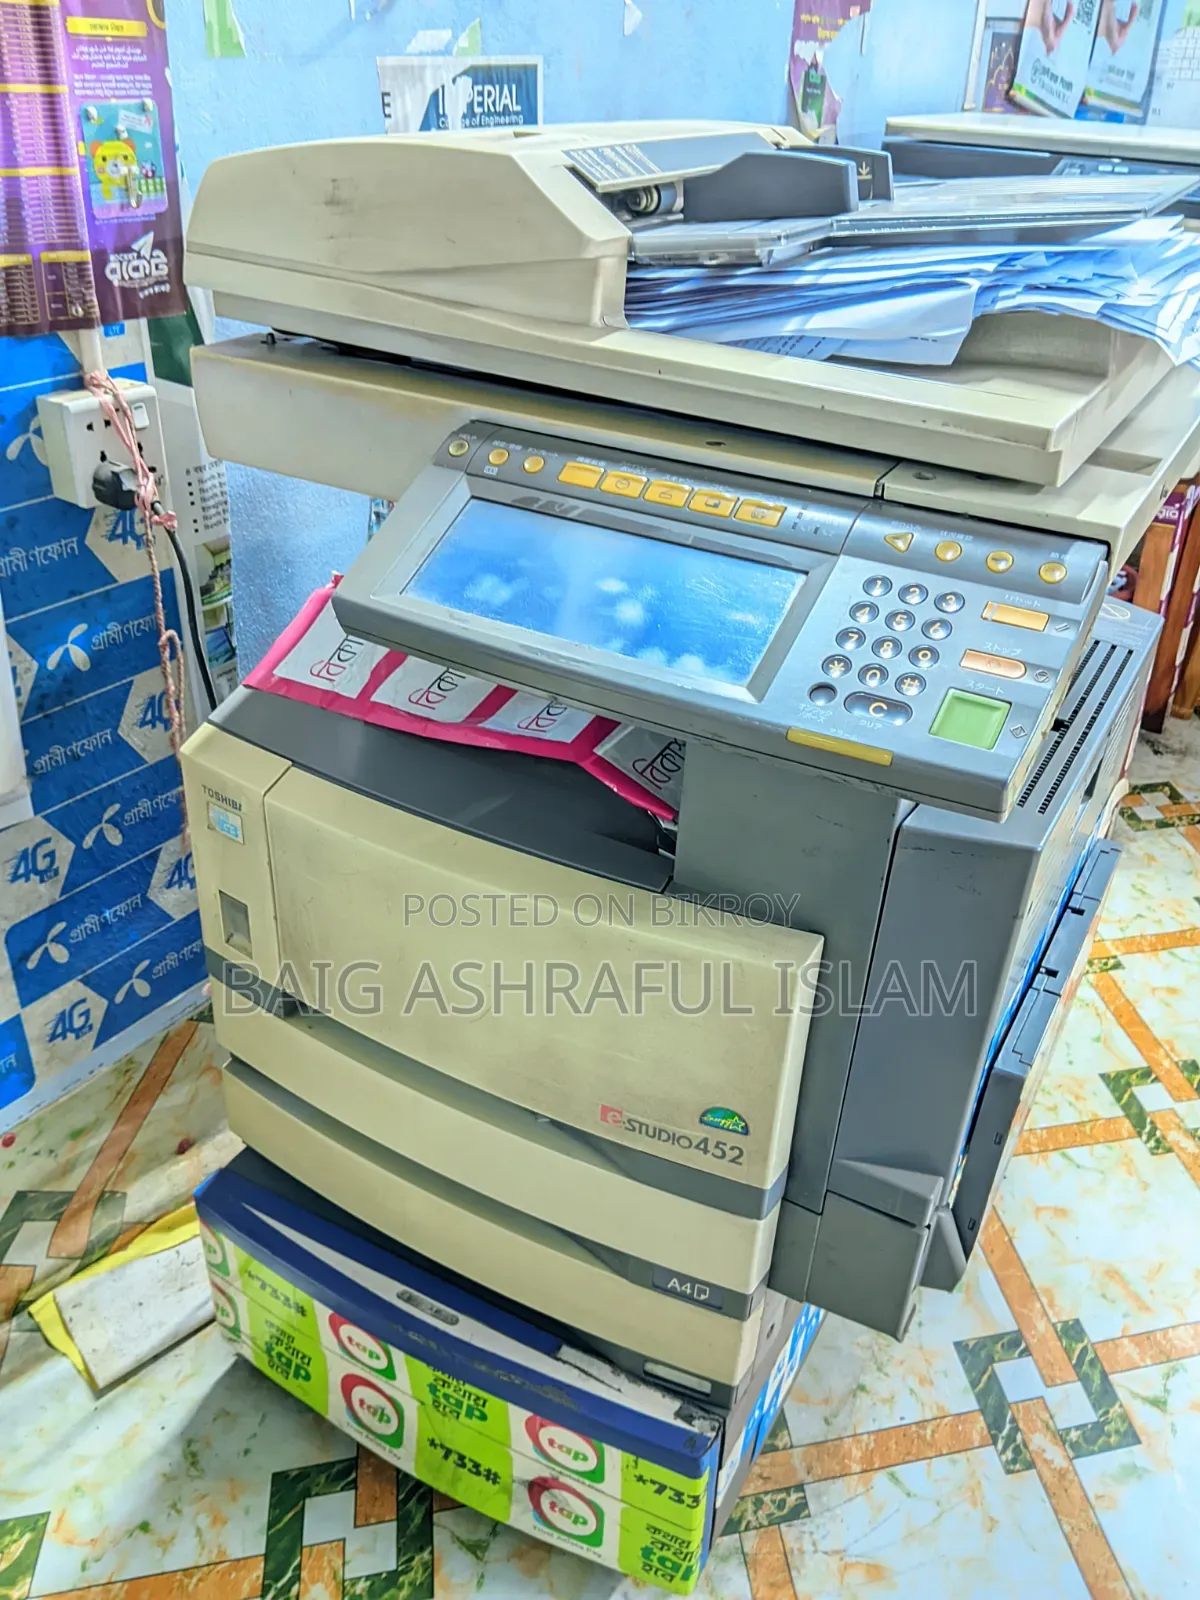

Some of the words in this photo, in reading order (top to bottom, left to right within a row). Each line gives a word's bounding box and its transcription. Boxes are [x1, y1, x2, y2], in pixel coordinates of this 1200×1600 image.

[481, 113, 524, 127] Engineering
[869, 701, 887, 718] C
[6, 836, 58, 884] 4G
[44, 997, 93, 1044] 4G
[667, 1277, 692, 1296] A4
[264, 1341, 312, 1383] tap
[346, 1335, 381, 1361] tap
[358, 1397, 392, 1425] tap
[426, 1382, 489, 1423] tap
[547, 1436, 589, 1463] tap
[548, 1499, 589, 1527] tap
